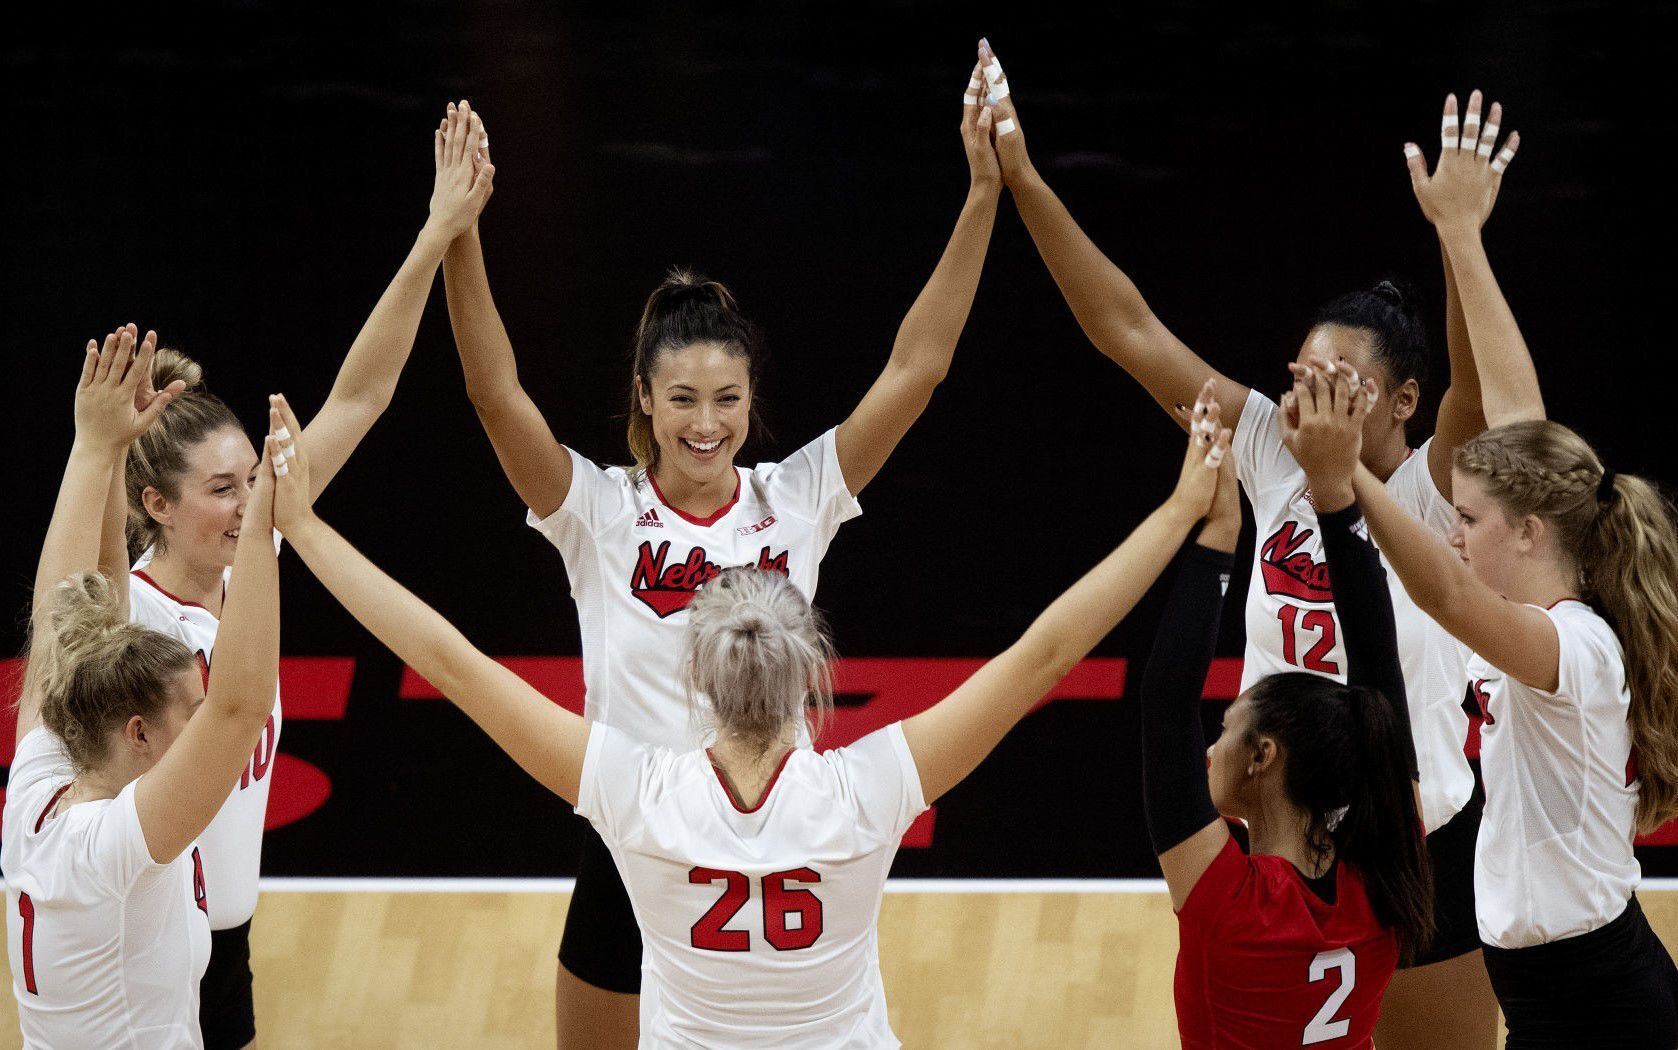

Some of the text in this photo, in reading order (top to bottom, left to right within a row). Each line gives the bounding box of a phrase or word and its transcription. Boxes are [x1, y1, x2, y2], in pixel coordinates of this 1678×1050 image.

[635, 519, 664, 529] adidas
[1277, 603, 1340, 675] 12
[688, 865, 823, 952] 26
[1301, 946, 1356, 1046] 2
